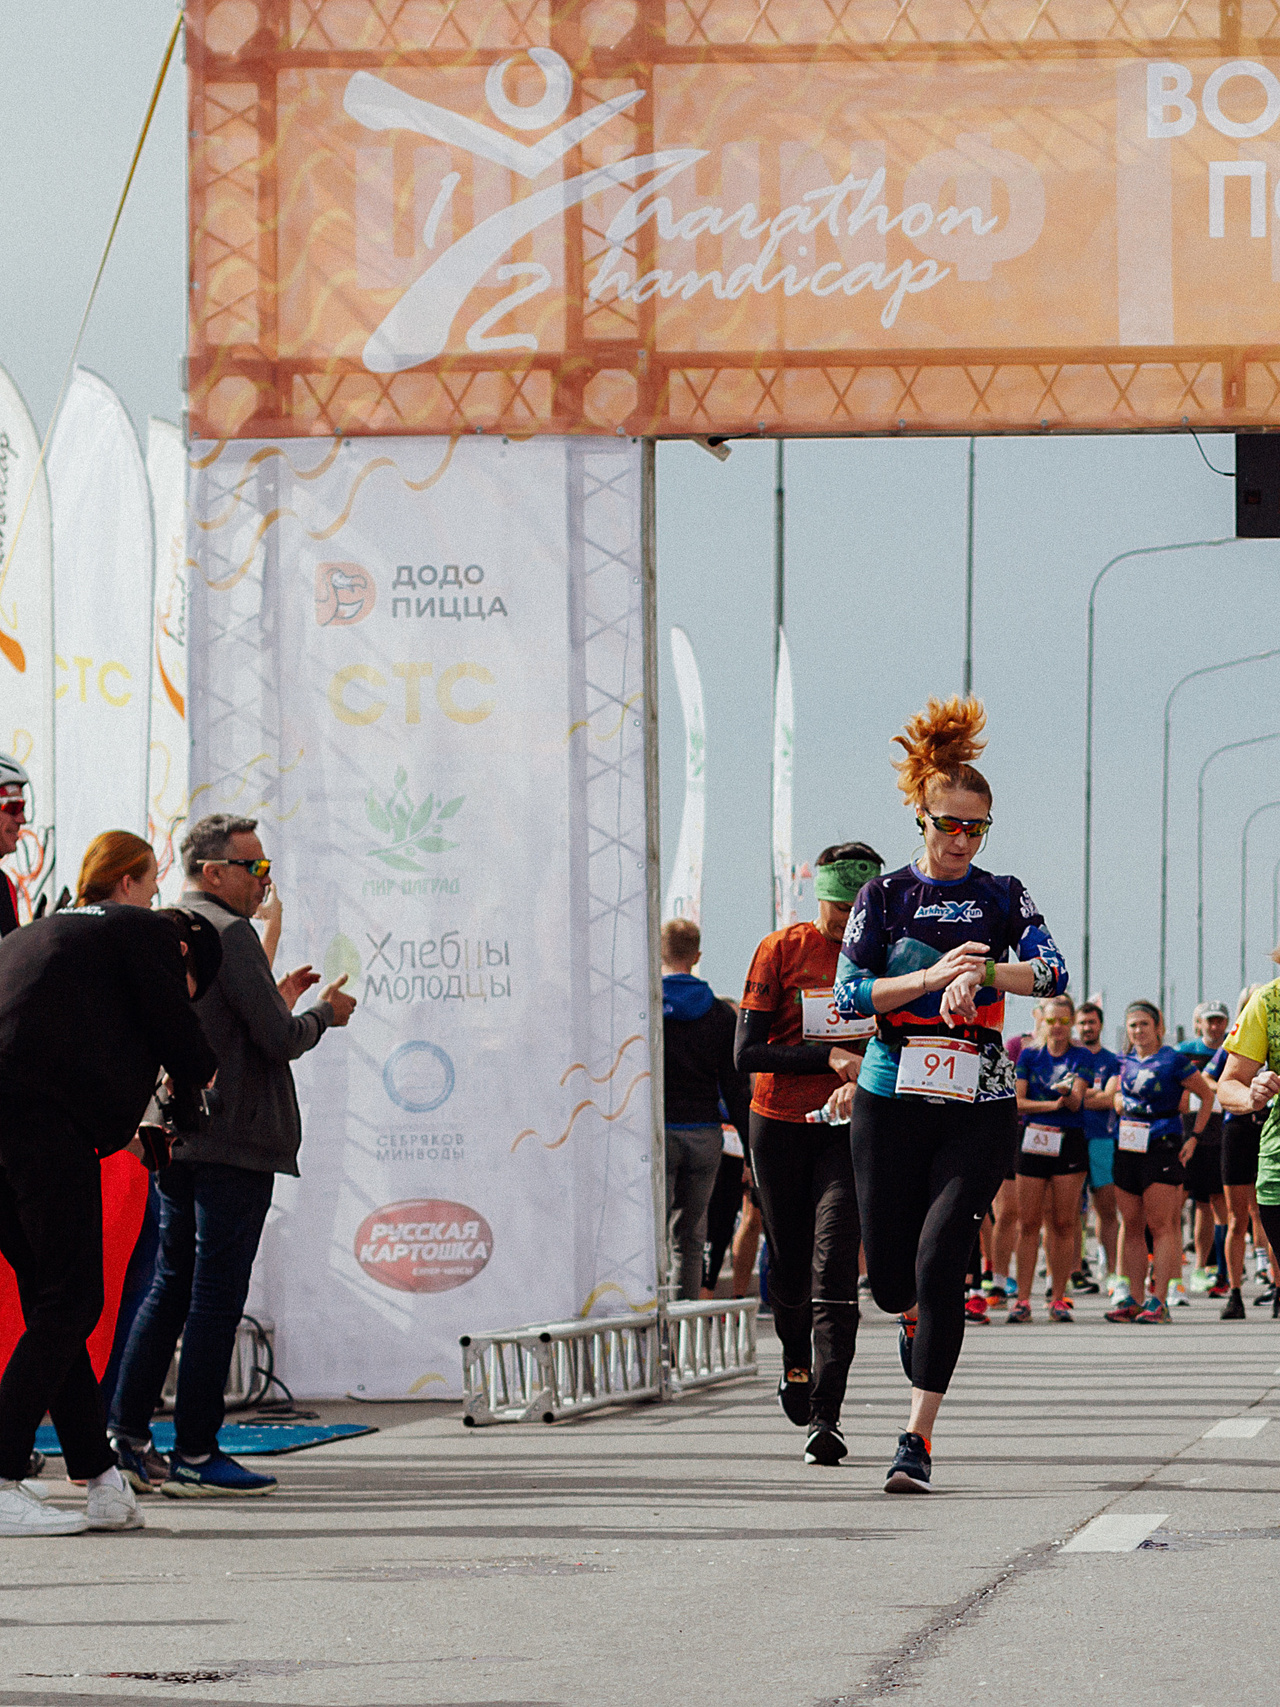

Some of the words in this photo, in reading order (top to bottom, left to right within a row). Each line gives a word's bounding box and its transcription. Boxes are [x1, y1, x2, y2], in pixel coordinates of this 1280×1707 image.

[587, 228, 950, 329] handicap
[391, 564, 484, 590] ДОДО
[391, 596, 508, 621] ПИЦЦА
[327, 662, 498, 726] СТС
[965, 908, 981, 917] run
[365, 930, 511, 974] Хлебцы
[924, 1053, 956, 1080] 91
[376, 1133, 465, 1147] СЕБРЯКОВ
[376, 1147, 465, 1161] МИНВОДЫ
[370, 1220, 481, 1243] РУССКАЯ
[359, 1240, 488, 1264] КАРТОШКА
